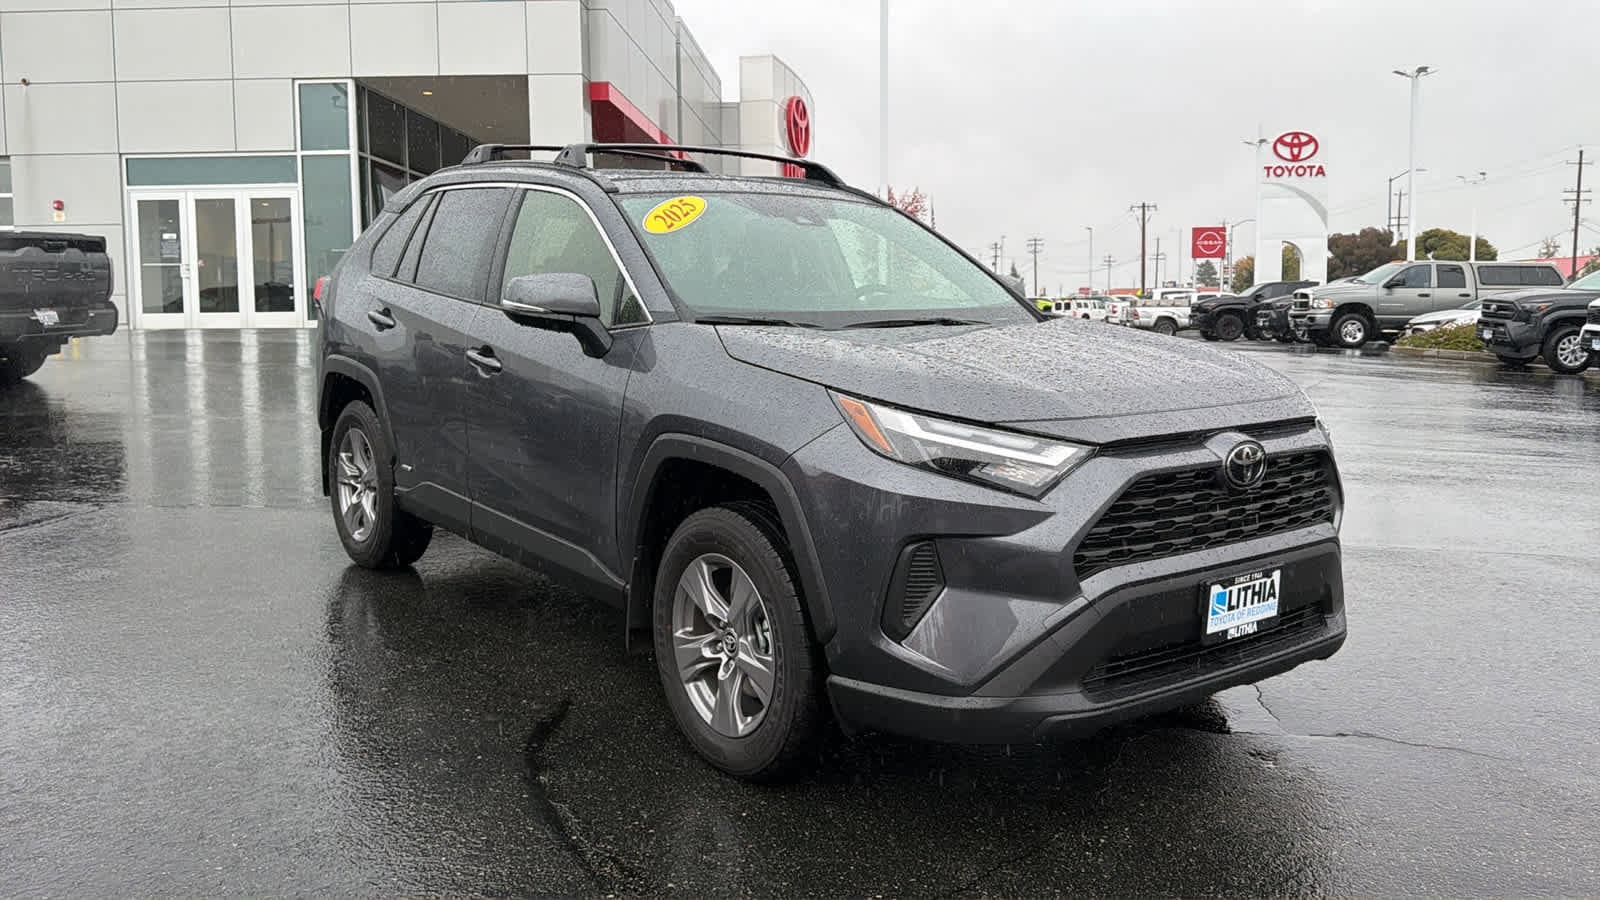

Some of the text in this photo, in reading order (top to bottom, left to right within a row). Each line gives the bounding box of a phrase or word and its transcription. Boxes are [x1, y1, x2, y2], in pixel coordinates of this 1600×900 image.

[1263, 165, 1326, 178] TOYOTA
[653, 198, 697, 229] 2025
[1234, 574, 1251, 585] SINCE
[1227, 579, 1277, 612] LITHIA
[1210, 600, 1278, 627] TOYOTA OF REDDING
[1234, 621, 1258, 637] LITHIA
